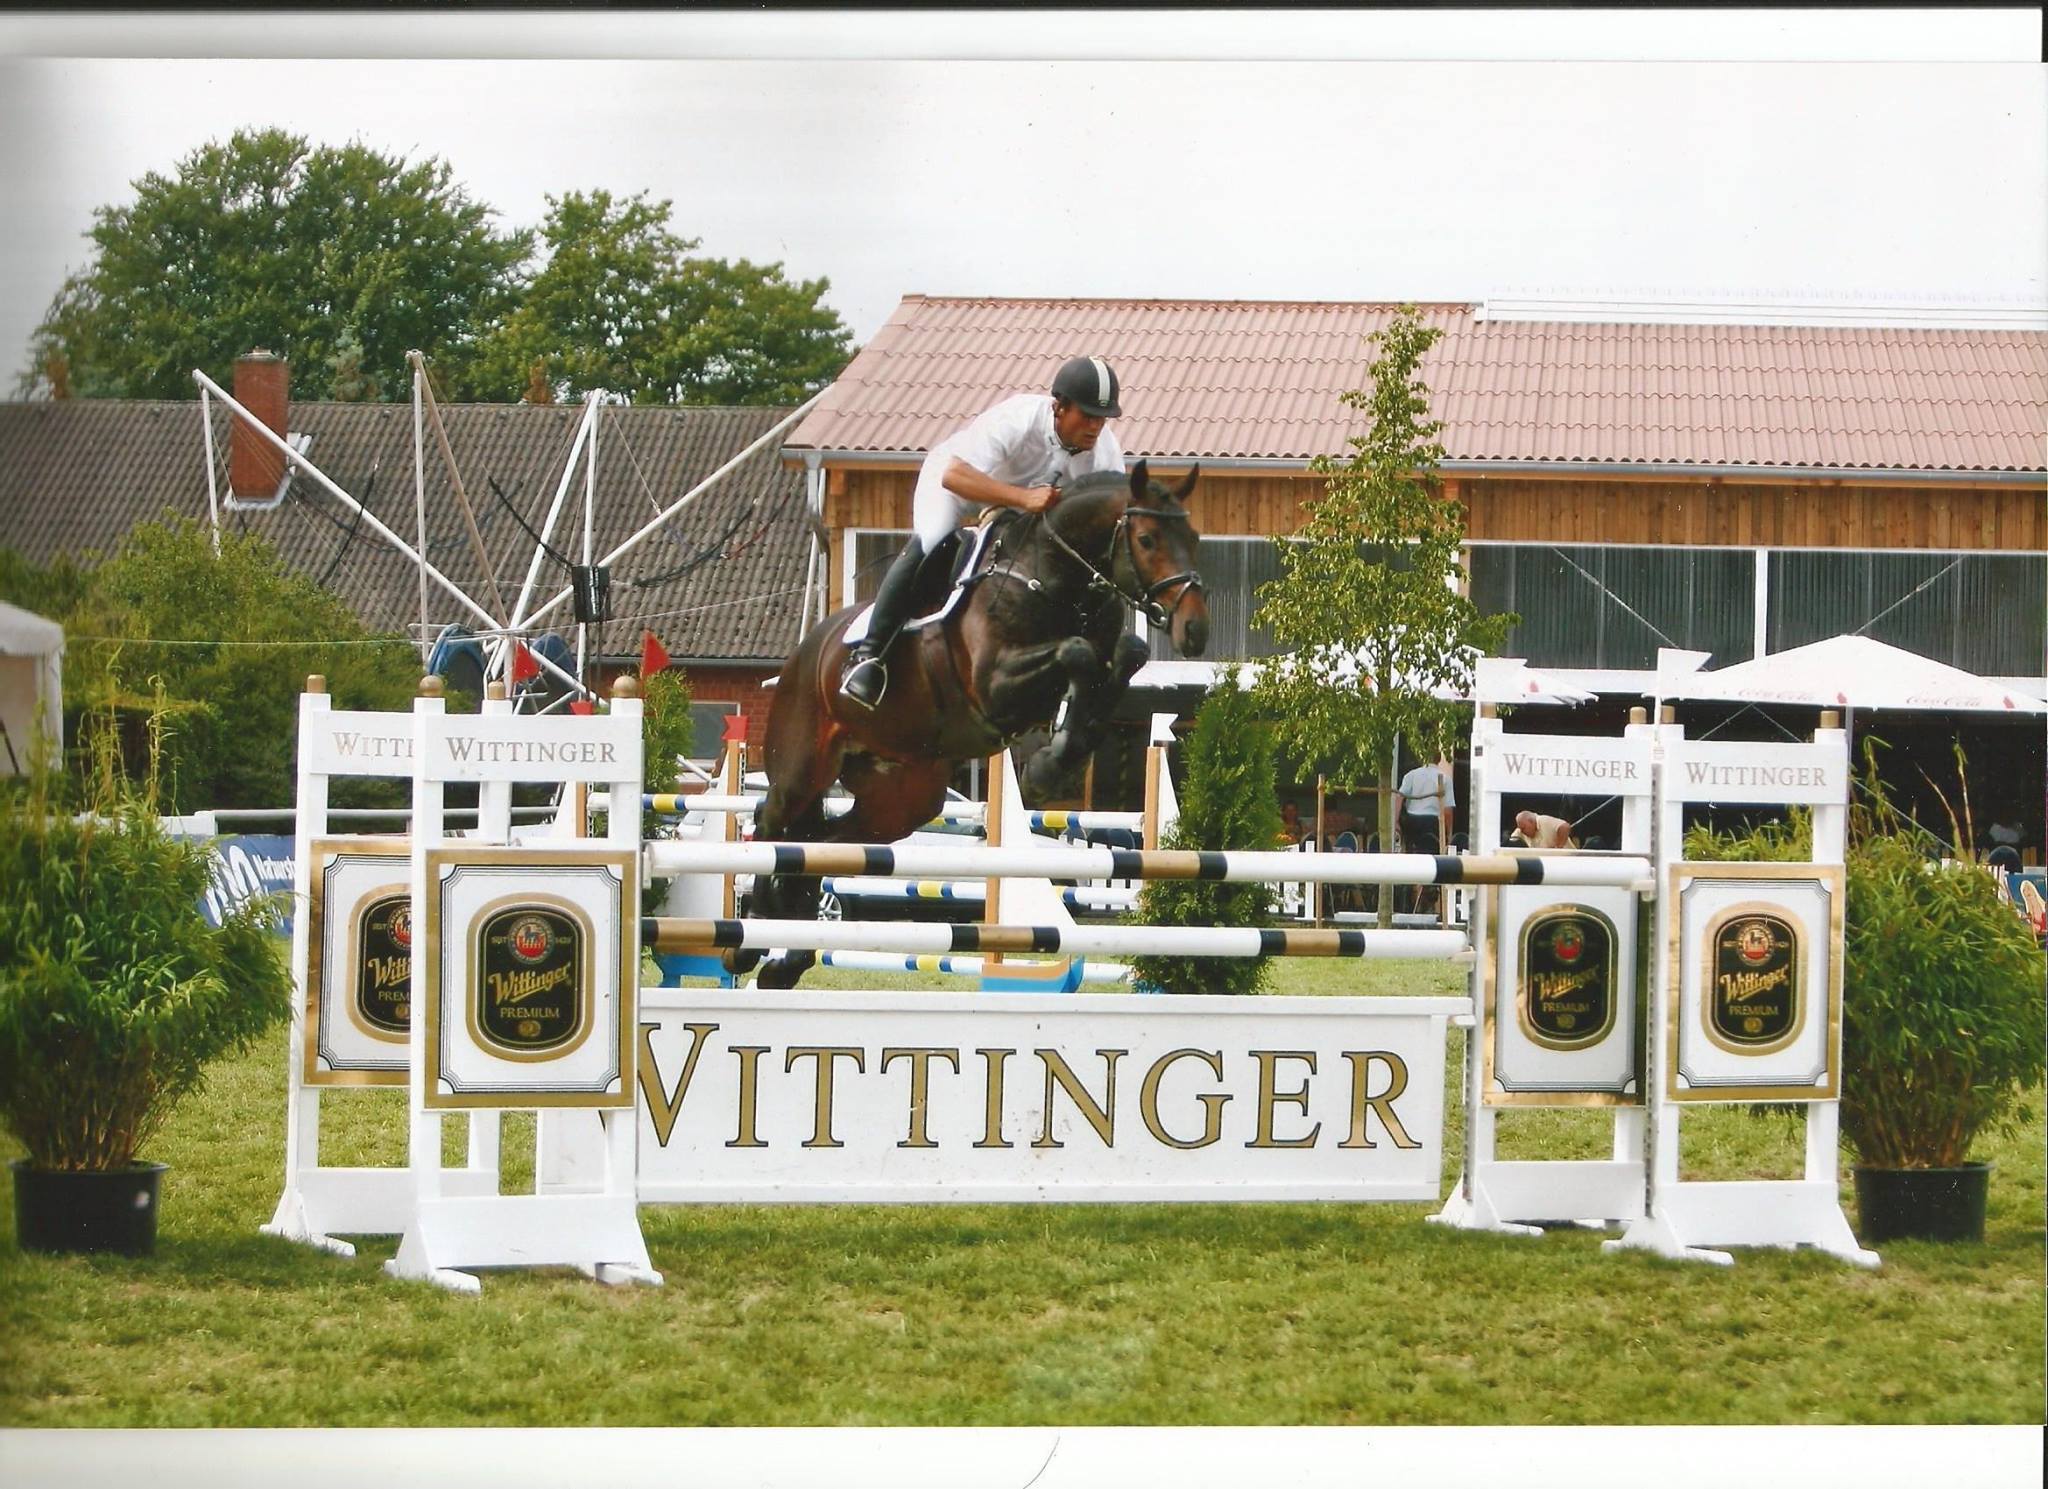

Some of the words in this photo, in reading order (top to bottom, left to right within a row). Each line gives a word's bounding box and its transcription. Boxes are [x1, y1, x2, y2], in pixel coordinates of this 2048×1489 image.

[332, 732, 413, 757] WITTI
[445, 736, 617, 763] WITTINGER
[1502, 753, 1638, 780] WITTINGER
[1685, 761, 1826, 787] WITTINGER
[367, 956, 411, 989] Witti
[488, 961, 571, 1005] Wittinger
[1720, 963, 1789, 1004] Wittinger
[378, 991, 411, 1001] PREM
[500, 1007, 560, 1018] PREMIUM
[1728, 1004, 1779, 1015] PREMIUM
